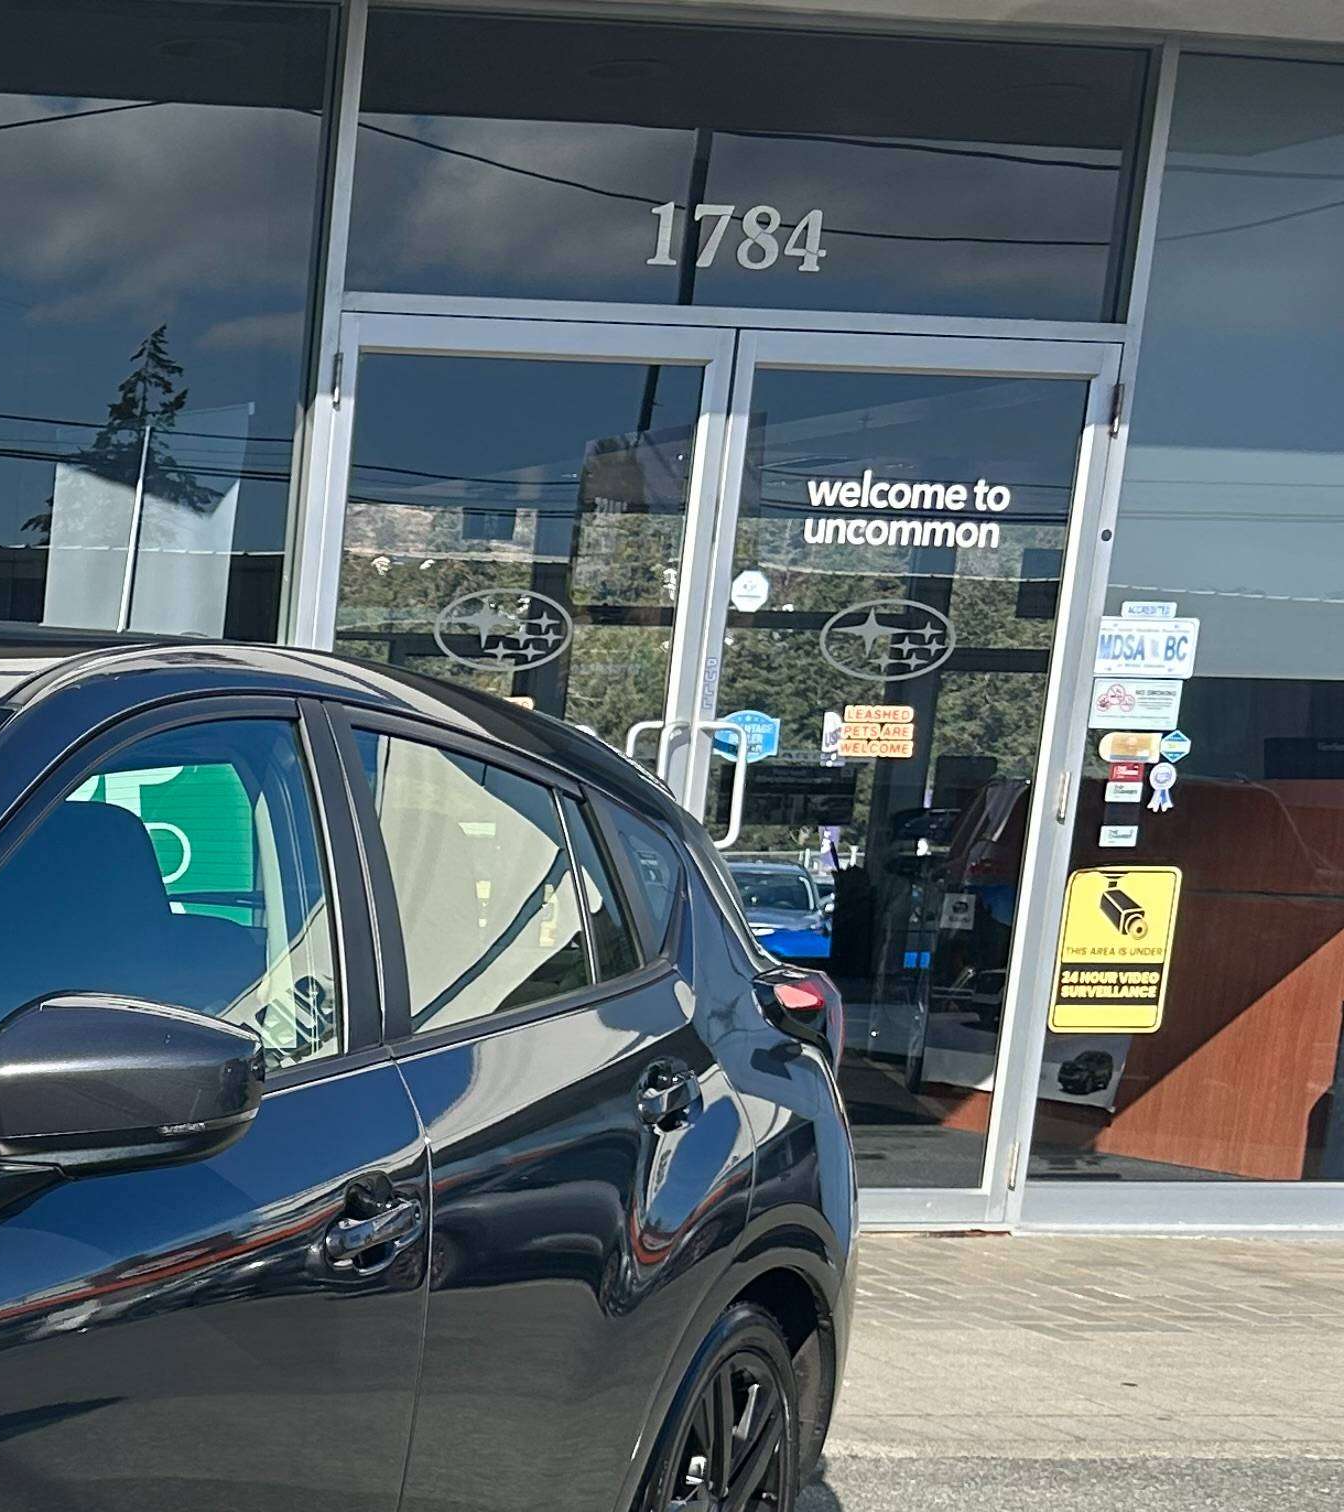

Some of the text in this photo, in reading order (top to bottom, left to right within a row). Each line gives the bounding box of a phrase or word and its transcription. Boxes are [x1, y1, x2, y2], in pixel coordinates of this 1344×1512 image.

[646, 201, 827, 272] 1784
[807, 469, 1011, 512] welcome to
[803, 517, 1000, 549] uncommon
[1097, 634, 1189, 662] MDSA BC
[847, 708, 910, 720] LEASHED
[844, 725, 910, 737] PETS ARE
[841, 742, 910, 754] WELCOME
[1066, 946, 1163, 957] THIS AREA IS UNDER
[1060, 970, 1161, 985] 24 HOUR VIDEO
[1060, 985, 1158, 998] SURVEILLANCE
